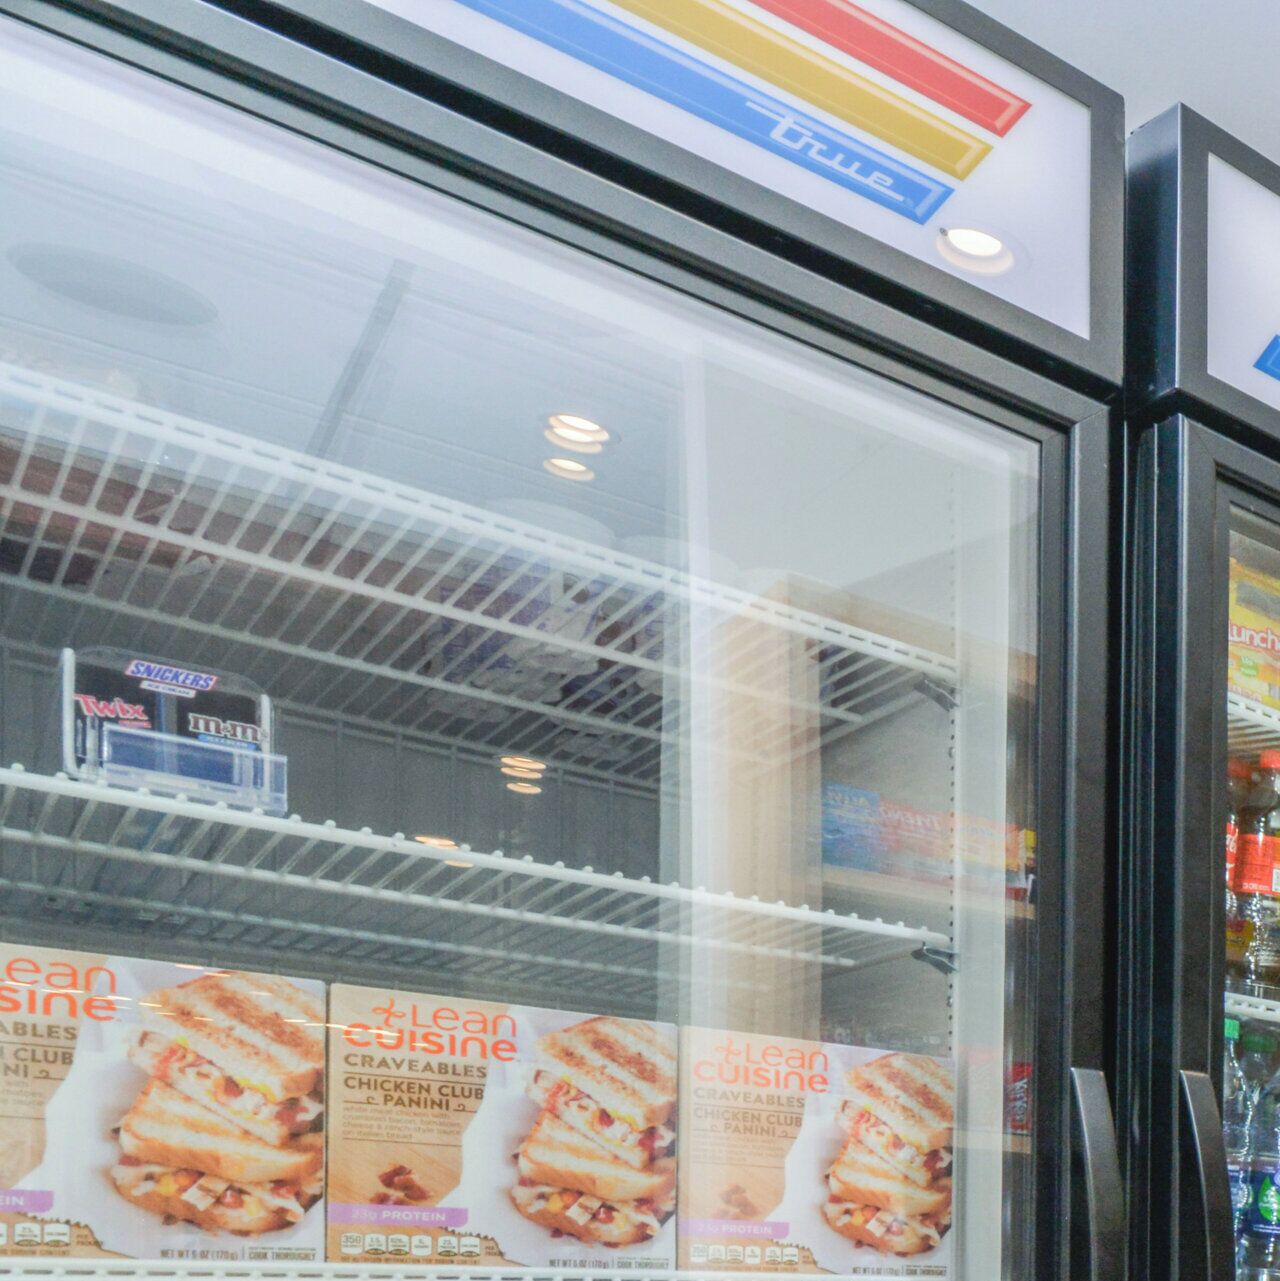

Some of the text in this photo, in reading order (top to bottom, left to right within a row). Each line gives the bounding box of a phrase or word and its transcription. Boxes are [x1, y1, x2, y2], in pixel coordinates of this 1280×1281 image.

[130, 661, 215, 690] SNICKERS
[0, 957, 116, 994] ean
[0, 985, 118, 1022] sine
[412, 1004, 517, 1037] Lean
[13, 1047, 74, 1065] CLUB
[344, 1053, 487, 1079] CRAVEABLES
[745, 1042, 829, 1072] Lean
[344, 1076, 485, 1100] CHICKEN CLUB
[694, 1087, 806, 1108] CRAVEABLES
[383, 1094, 450, 1112] PANINI
[694, 1107, 803, 1127] CHICKEN CLUB
[723, 1122, 776, 1138] PANINI
[382, 1210, 447, 1222] PROTEIN
[721, 1223, 773, 1235] PROTEIN
